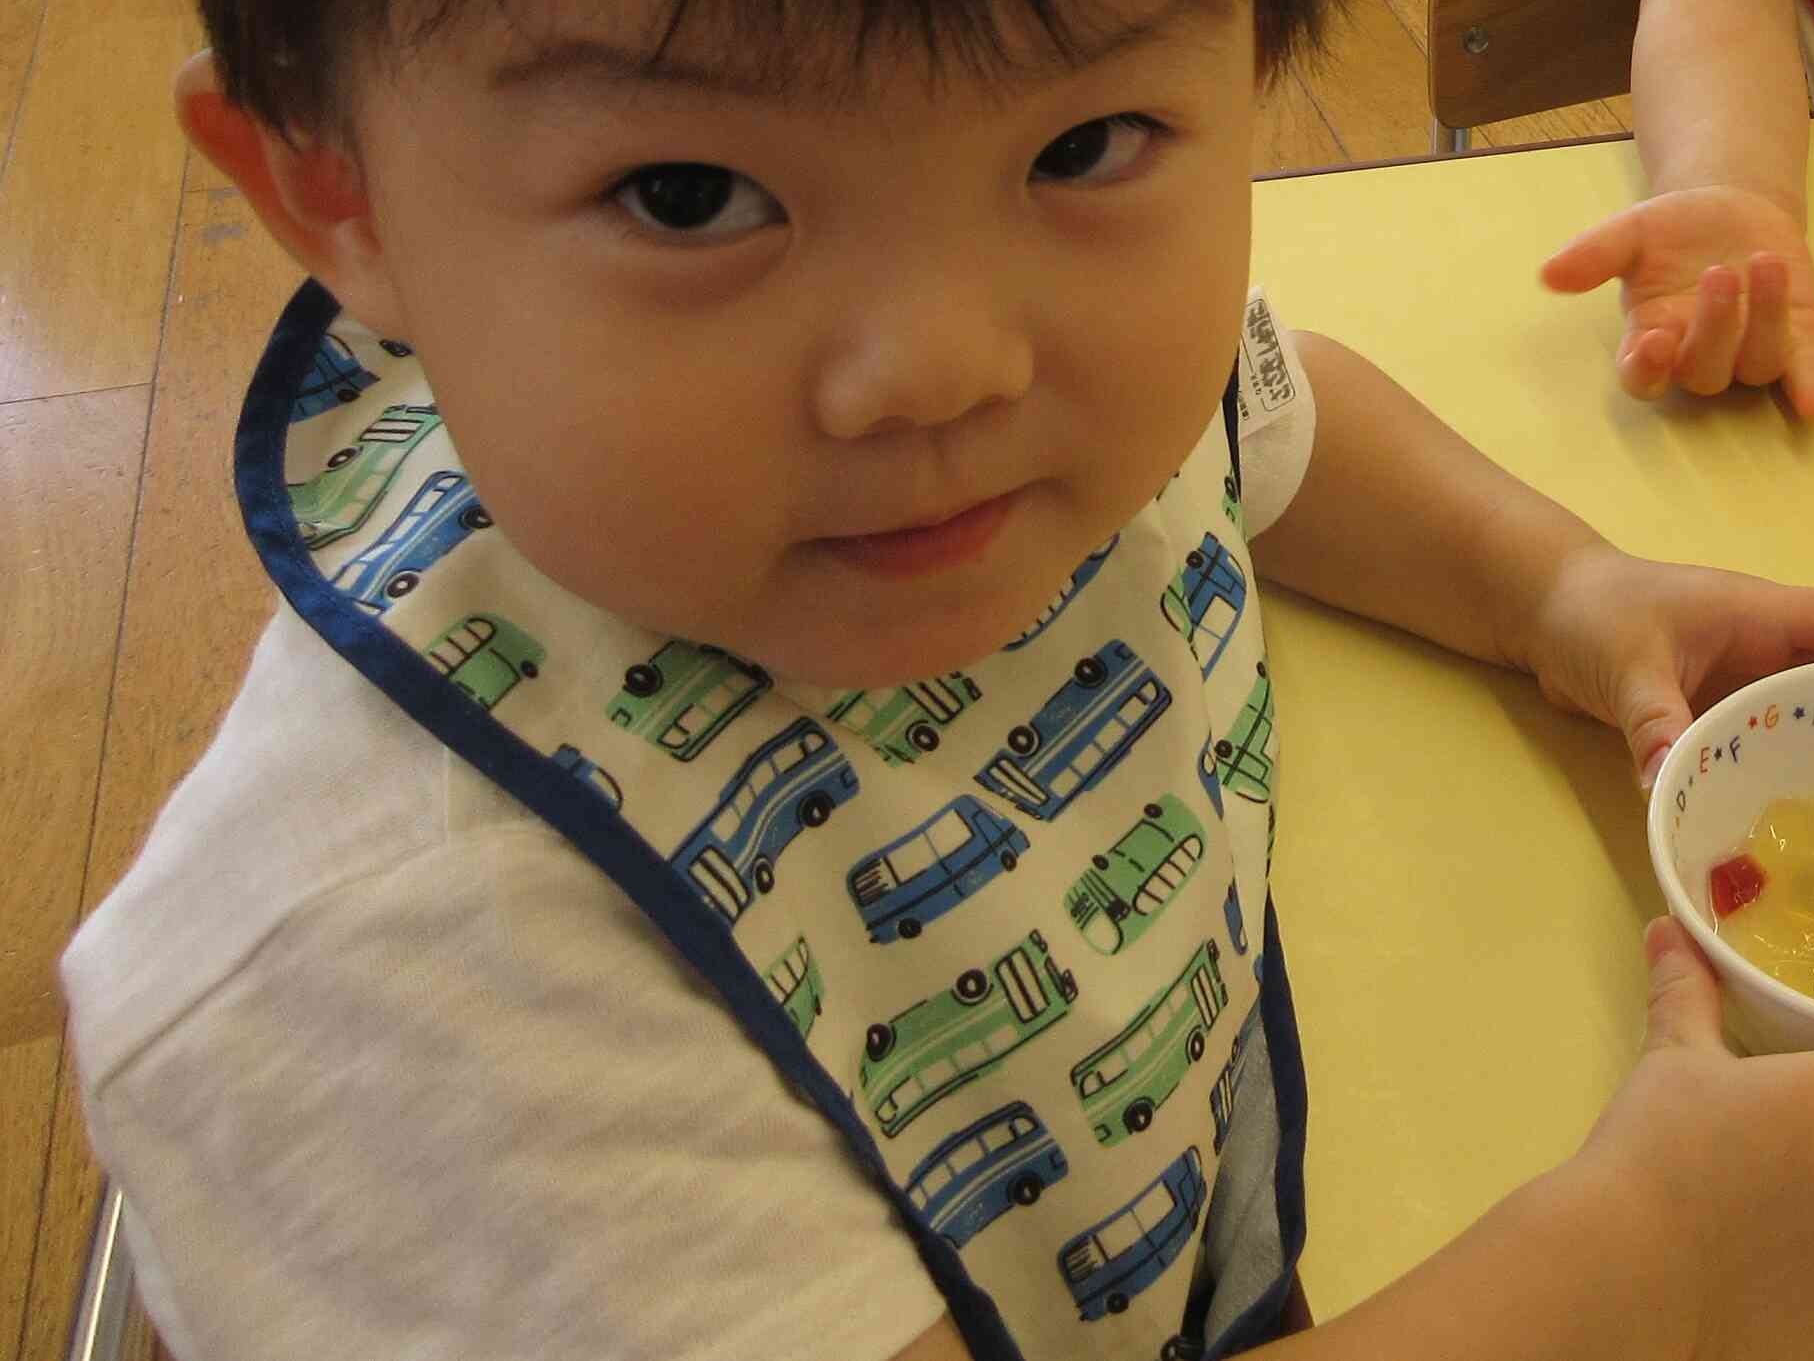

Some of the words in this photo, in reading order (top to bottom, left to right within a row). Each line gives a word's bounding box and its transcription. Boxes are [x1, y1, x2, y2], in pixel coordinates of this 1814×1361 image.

[1699, 746, 1711, 774] E
[1729, 735, 1741, 763] F
[1764, 703, 1780, 730] G
